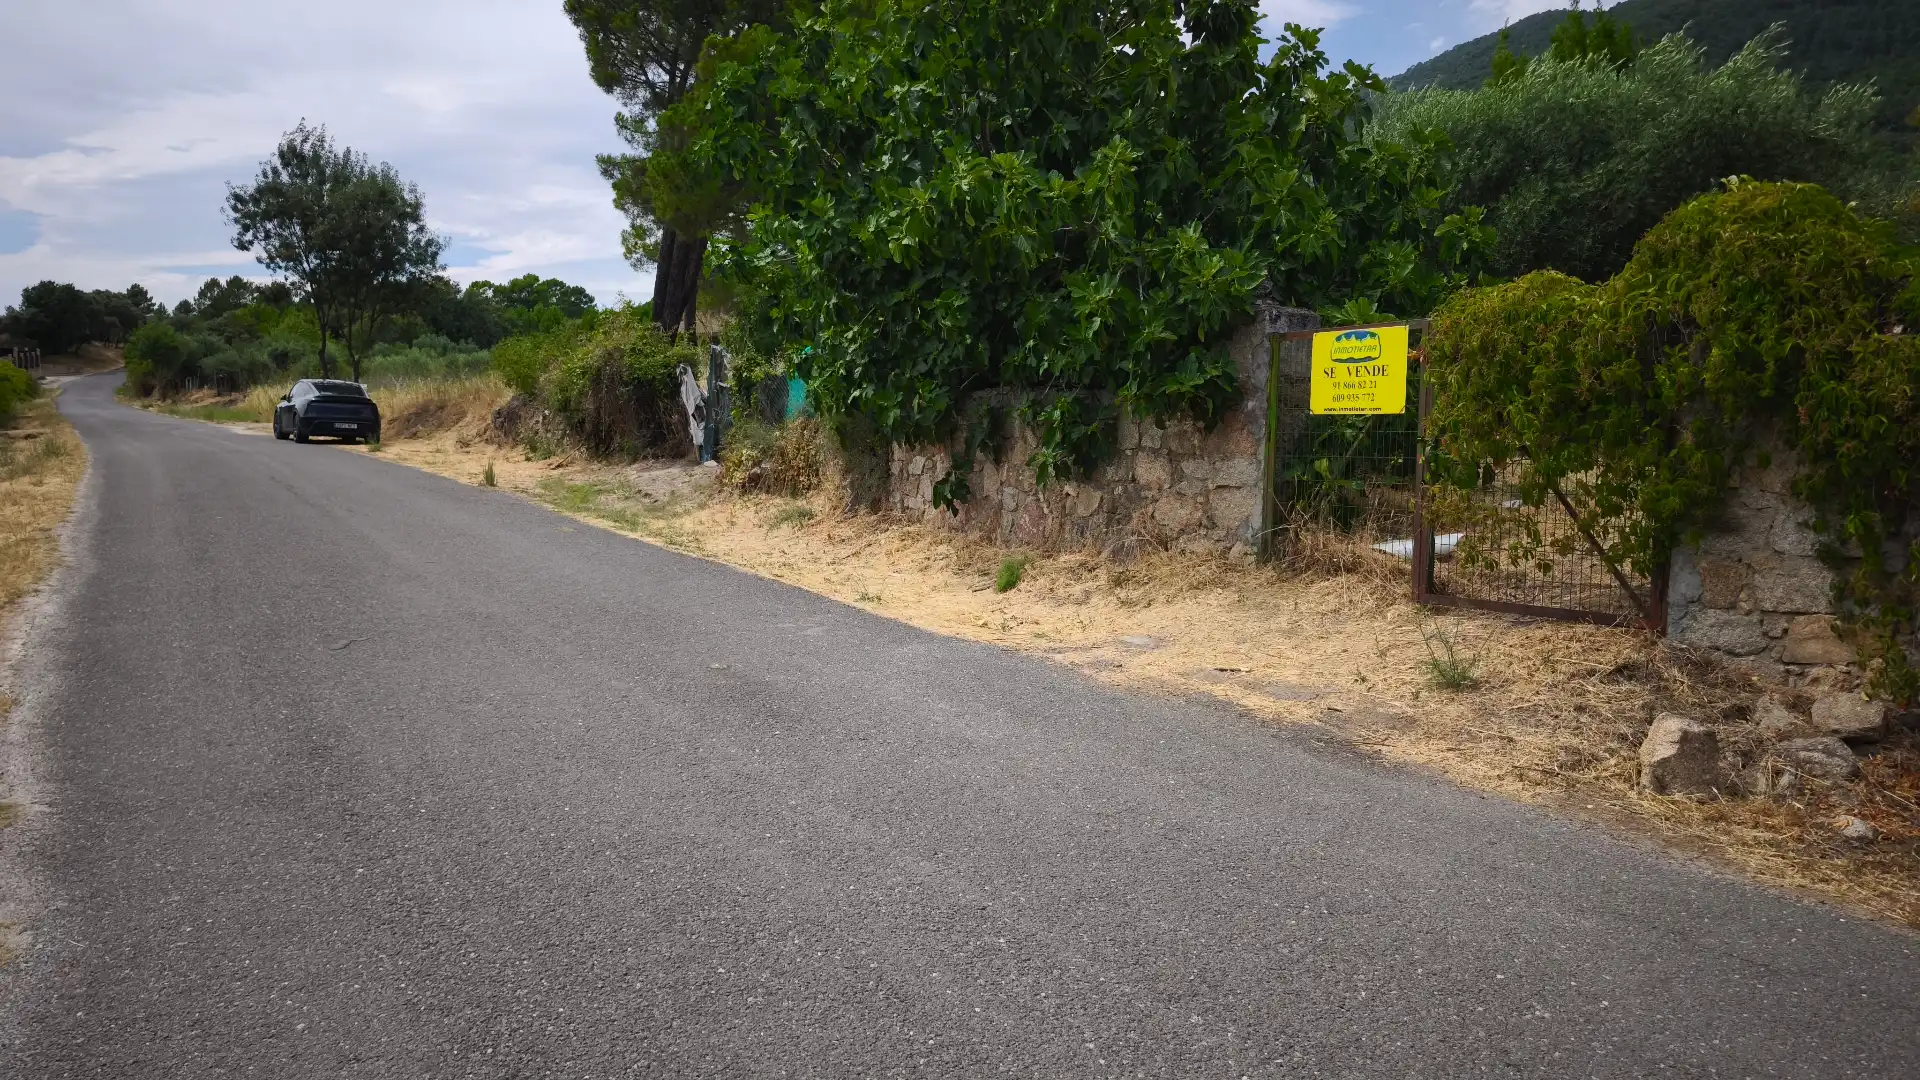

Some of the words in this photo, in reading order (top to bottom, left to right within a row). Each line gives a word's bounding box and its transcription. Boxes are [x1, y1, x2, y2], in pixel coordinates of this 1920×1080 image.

[1323, 366, 1337, 378] SE
[1347, 364, 1389, 378] VENDE
[1332, 381, 1341, 390] 91
[1343, 381, 1356, 389] 866
[1357, 380, 1367, 389] 82
[1368, 380, 1377, 389] 21
[1332, 394, 1345, 402] 609
[1346, 393, 1360, 402] 935
[1362, 392, 1375, 402] 772
